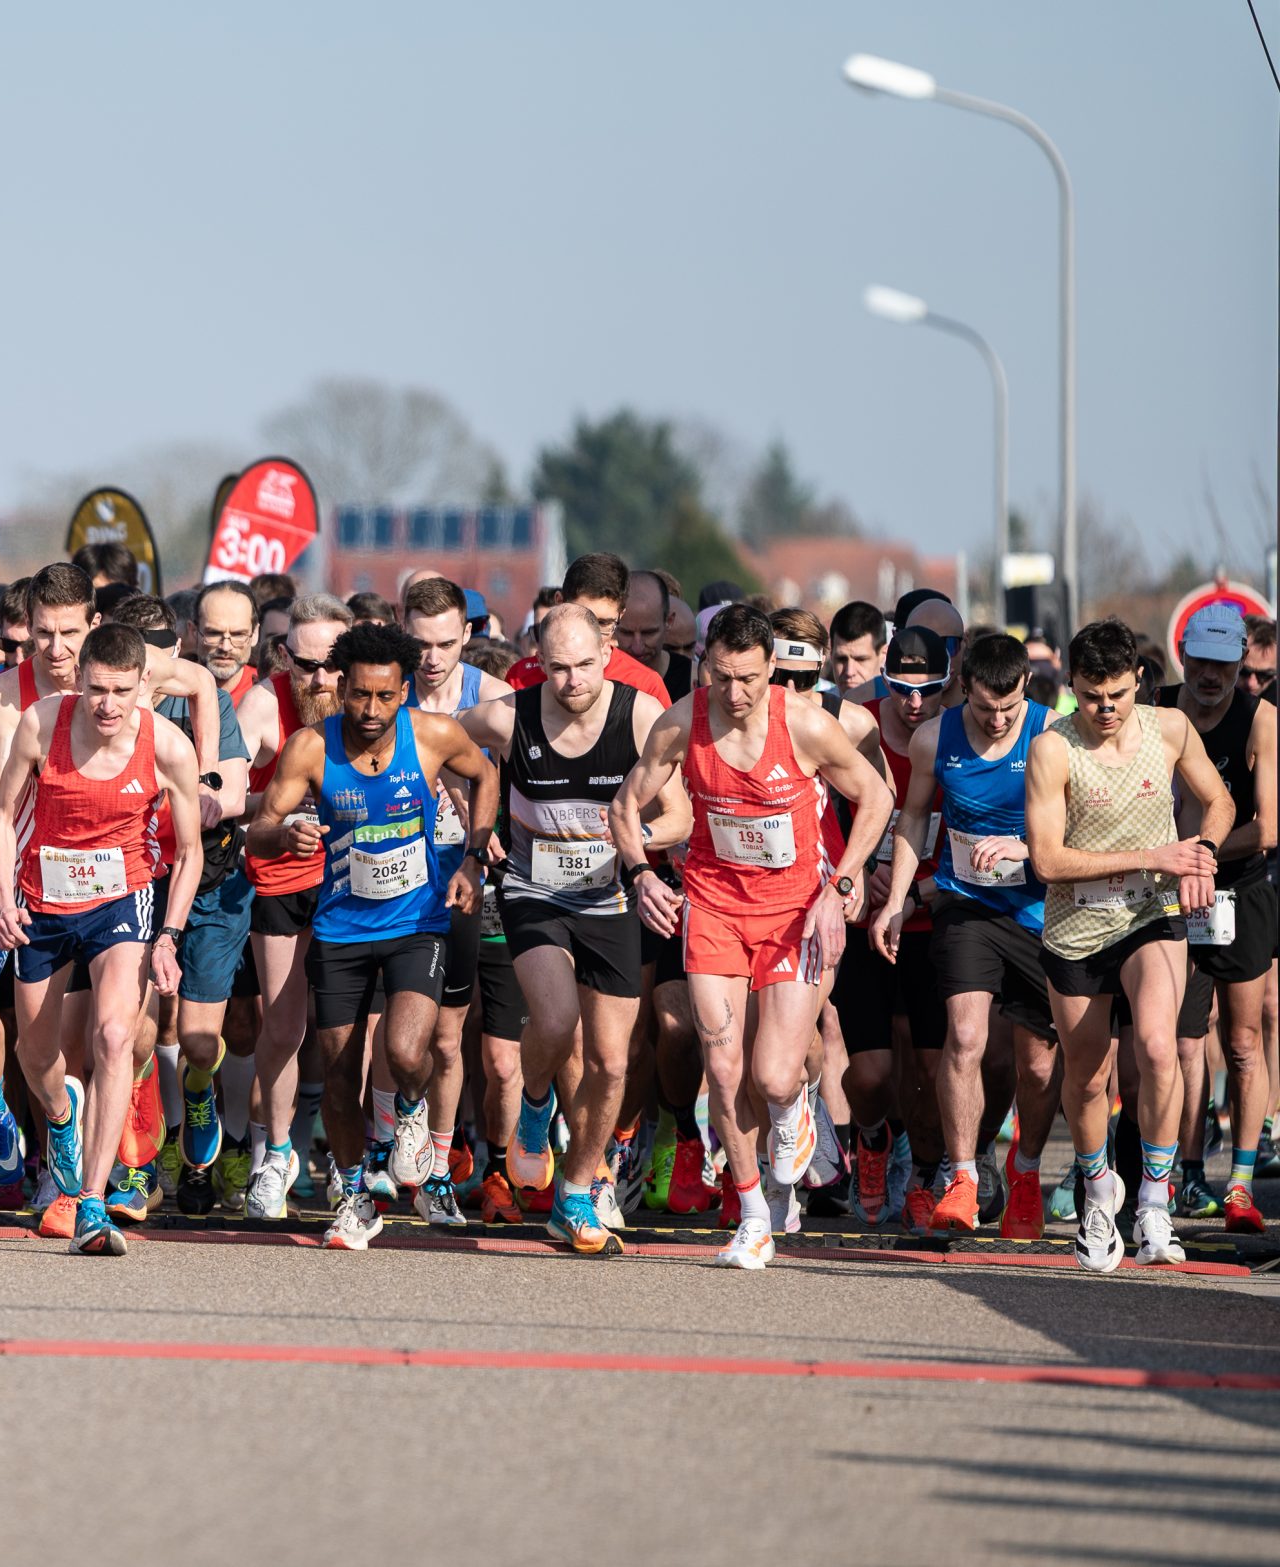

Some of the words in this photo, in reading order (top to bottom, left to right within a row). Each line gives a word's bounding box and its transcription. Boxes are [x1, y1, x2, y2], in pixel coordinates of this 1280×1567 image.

[217, 526, 287, 575] 3:00
[389, 775, 401, 783] Top
[406, 772, 420, 782] Life
[1136, 790, 1159, 798] SAYSKY
[543, 807, 599, 822] LÜBBERS
[738, 831, 764, 844] 193
[372, 860, 407, 878] 2082
[558, 856, 591, 869] 1381
[68, 865, 96, 878] 344
[376, 874, 405, 885] MERHAWI
[429, 942, 439, 978] ENDURANCE
[705, 1036, 732, 1048] MMXIV
